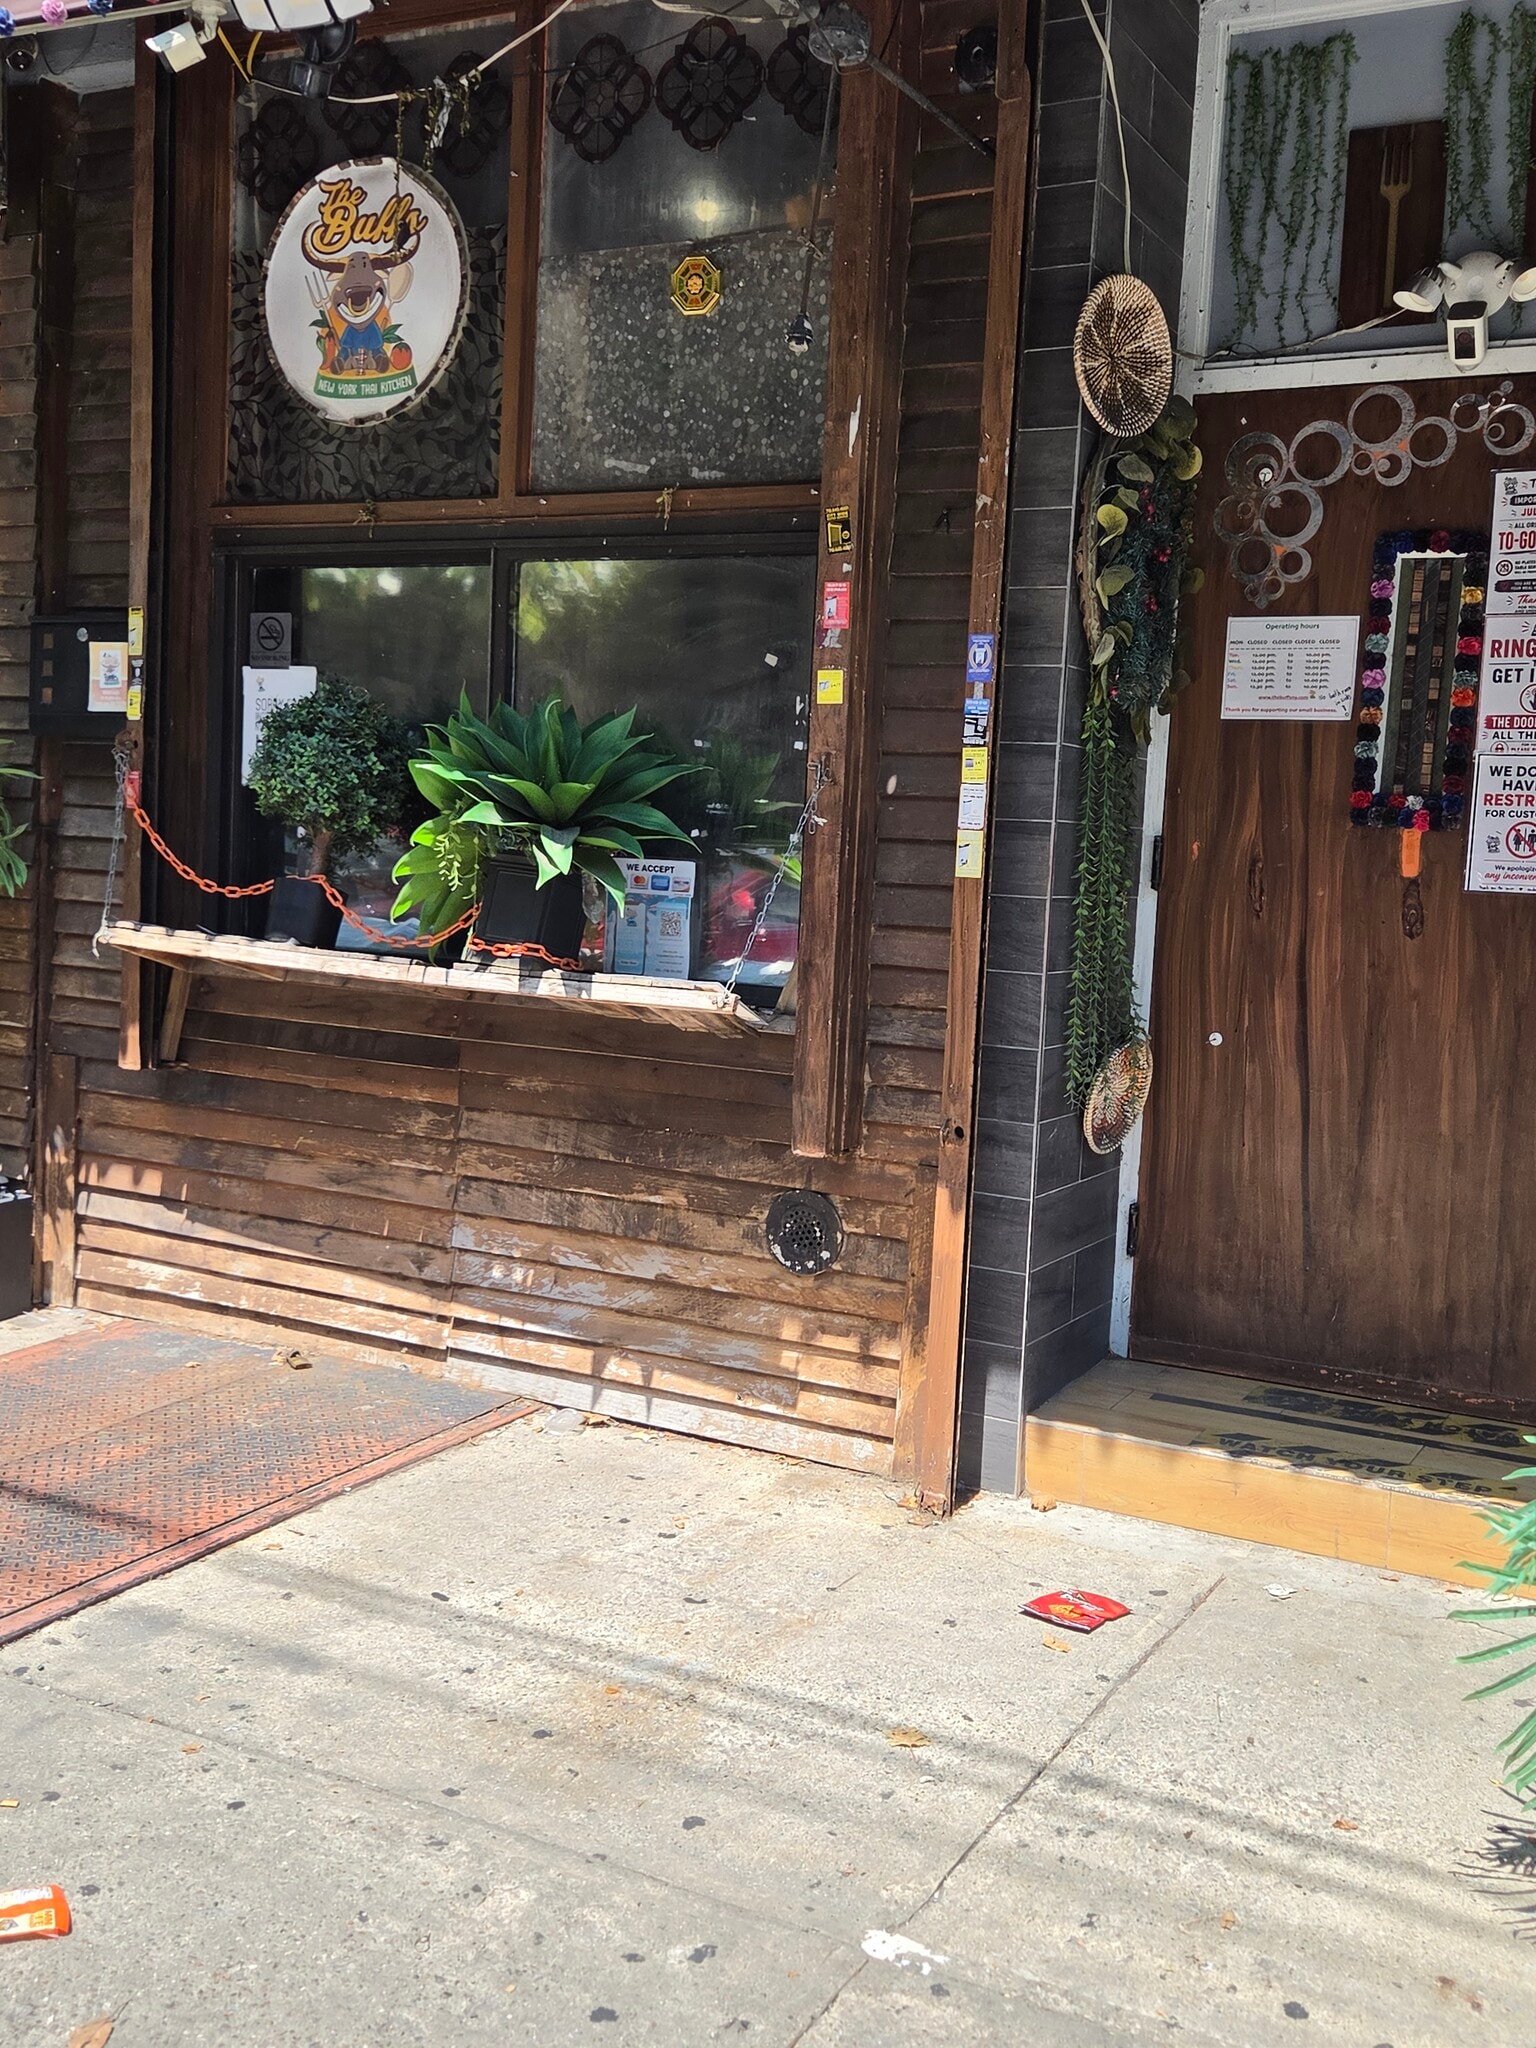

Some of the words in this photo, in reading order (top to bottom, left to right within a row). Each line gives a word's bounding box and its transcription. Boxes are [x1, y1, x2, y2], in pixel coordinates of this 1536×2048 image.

[319, 177, 367, 207] The
[319, 380, 335, 393] NEW
[338, 384, 358, 395] YORK
[361, 384, 378, 395] THAI
[380, 375, 412, 394] KITCHEN
[1490, 638, 1536, 658] RING
[1492, 668, 1524, 683] GET
[1492, 717, 1510, 728] THE
[1490, 766, 1512, 777] WE
[1503, 780, 1536, 791] HAV
[626, 863, 639, 872] WE
[641, 865, 675, 873] ACCEPT
[1484, 873, 1501, 882] any
[1219, 1438, 1315, 1461] WATCH
[1326, 1457, 1405, 1478] YOUR
[1416, 1474, 1492, 1493] STEP
